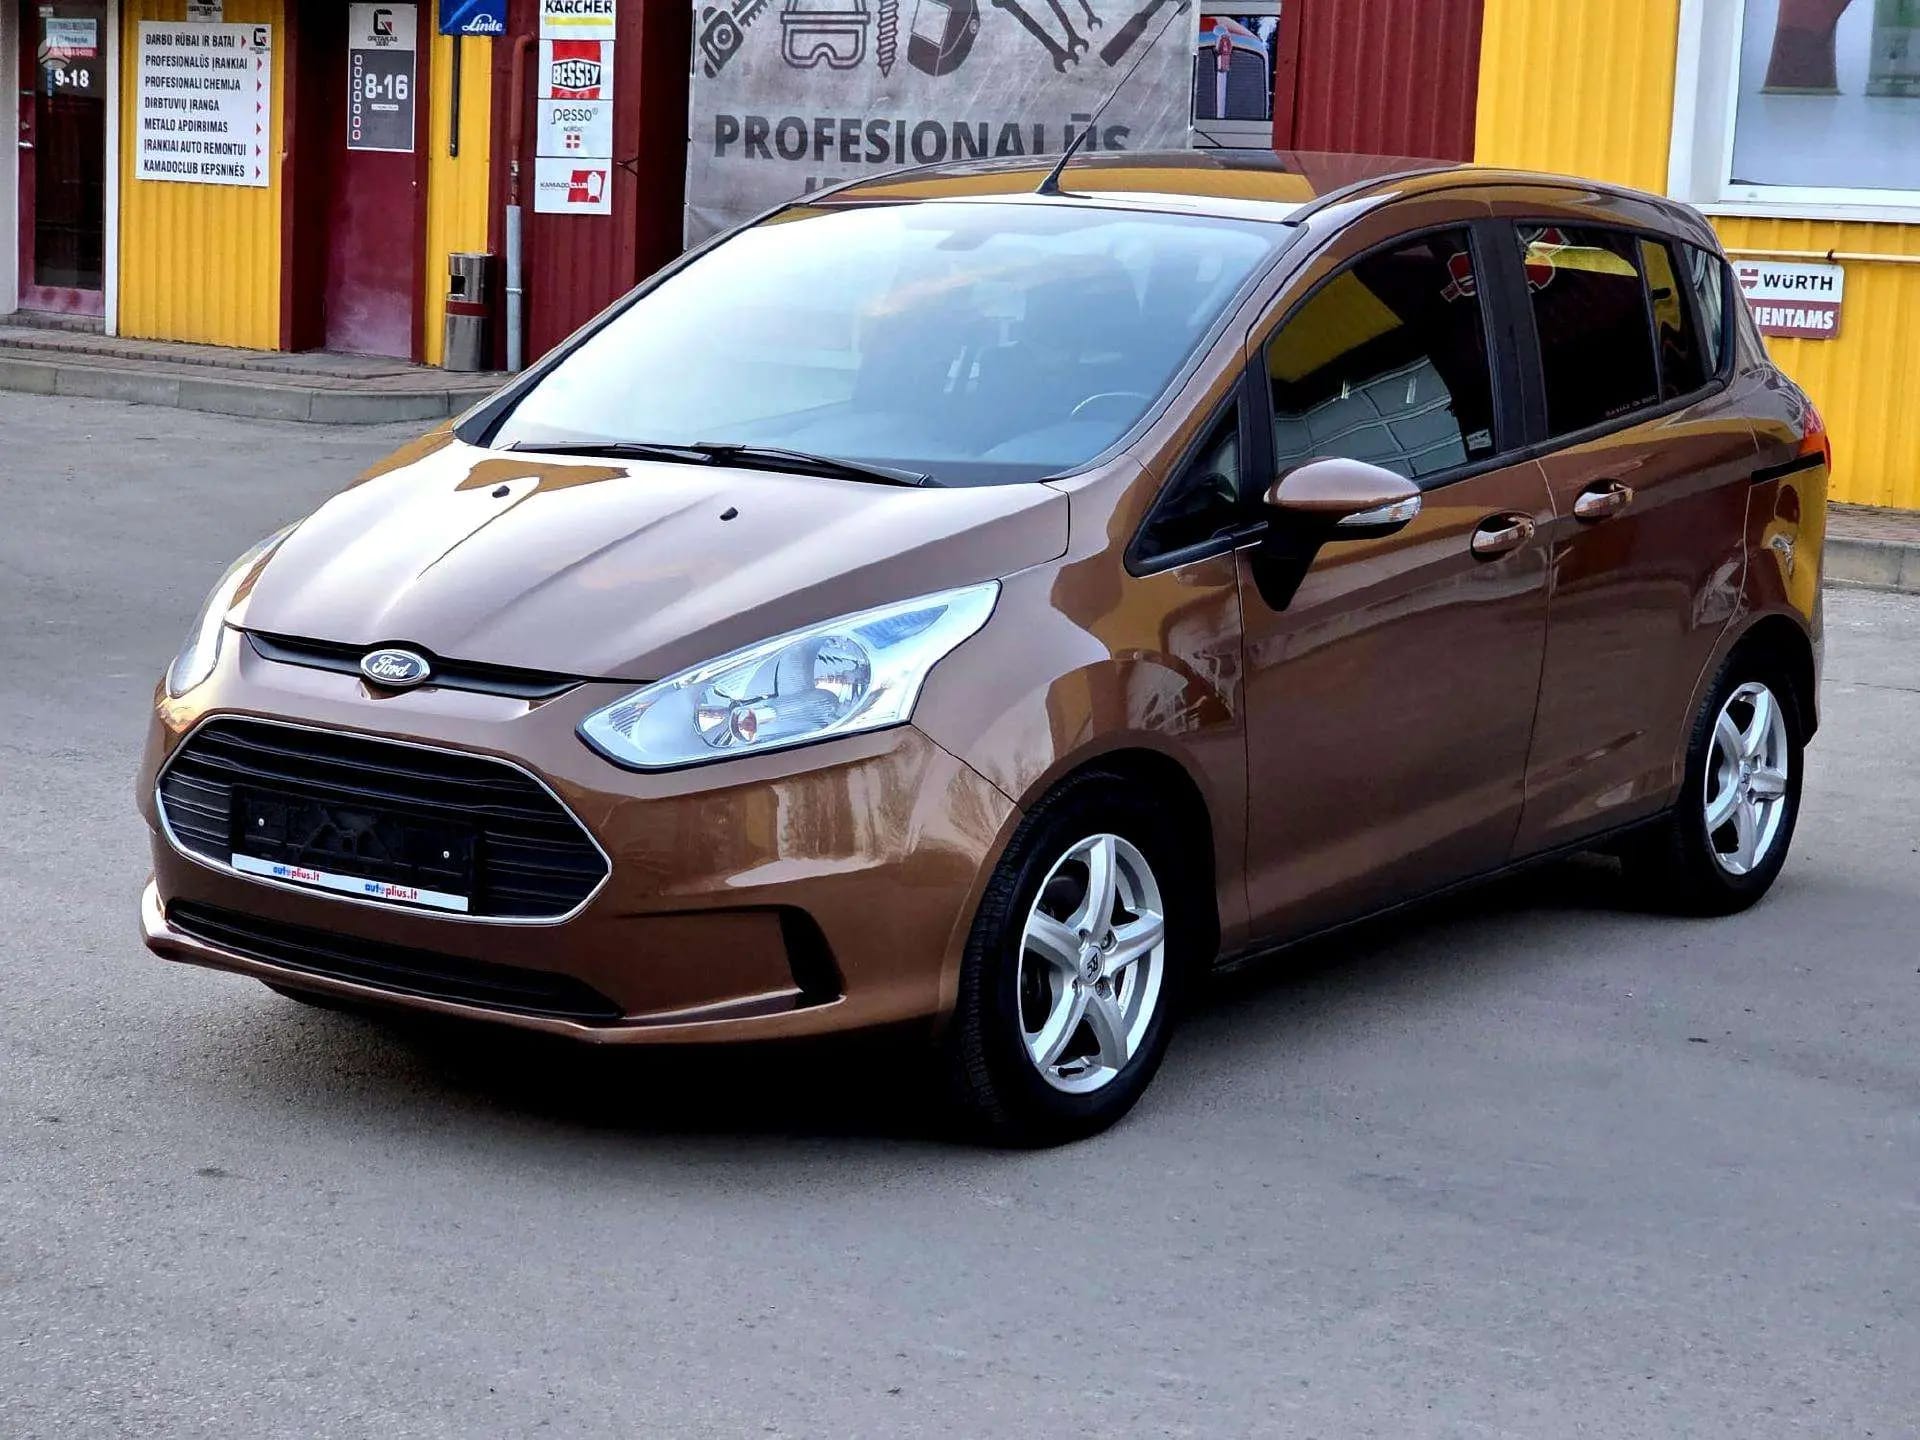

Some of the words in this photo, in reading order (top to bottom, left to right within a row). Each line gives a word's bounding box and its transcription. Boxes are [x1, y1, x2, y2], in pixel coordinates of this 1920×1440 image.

[461, 13, 503, 32] Linde
[146, 33, 173, 46] DARBO
[202, 34, 210, 47] IR
[212, 35, 235, 48] BATAI
[212, 57, 248, 72] ĮRANKIAI
[55, 68, 89, 88] 9-18
[145, 76, 202, 90] PROFESIONALI
[204, 78, 241, 91] CHEMIJA
[552, 62, 600, 87] BESSEY
[365, 73, 408, 100] 8-16
[189, 98, 220, 114] ĮRANGA
[144, 118, 176, 132] METALO
[178, 119, 229, 133] APDIRBIMAS
[144, 138, 179, 154] ĮRANKIAI
[180, 141, 202, 154] AUTO
[204, 142, 247, 156] REMONTUI
[143, 159, 199, 174] KAMADOCLUB
[201, 162, 245, 178] KEPSNINĖS
[1763, 274, 1834, 291] WÜRTH
[1753, 306, 1834, 330] IENTAMS
[371, 655, 409, 677] Ford
[364, 882, 418, 900] autoplius.lt
